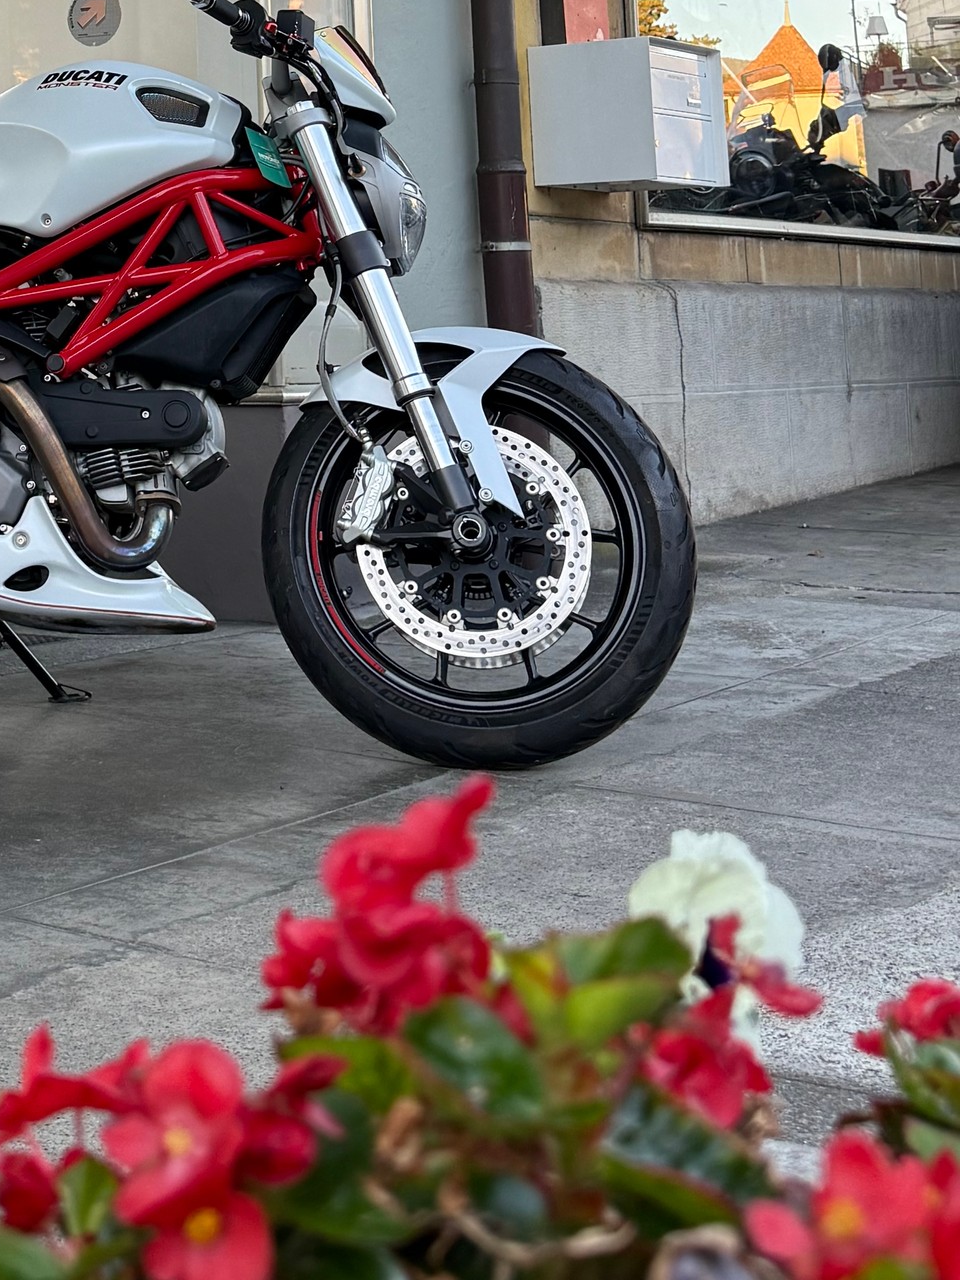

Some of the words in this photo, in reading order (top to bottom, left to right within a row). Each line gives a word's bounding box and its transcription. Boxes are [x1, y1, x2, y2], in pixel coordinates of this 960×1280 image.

[36, 81, 119, 91] MONSTER
[41, 69, 129, 86] DUCATI
[359, 475, 384, 518] brembo
